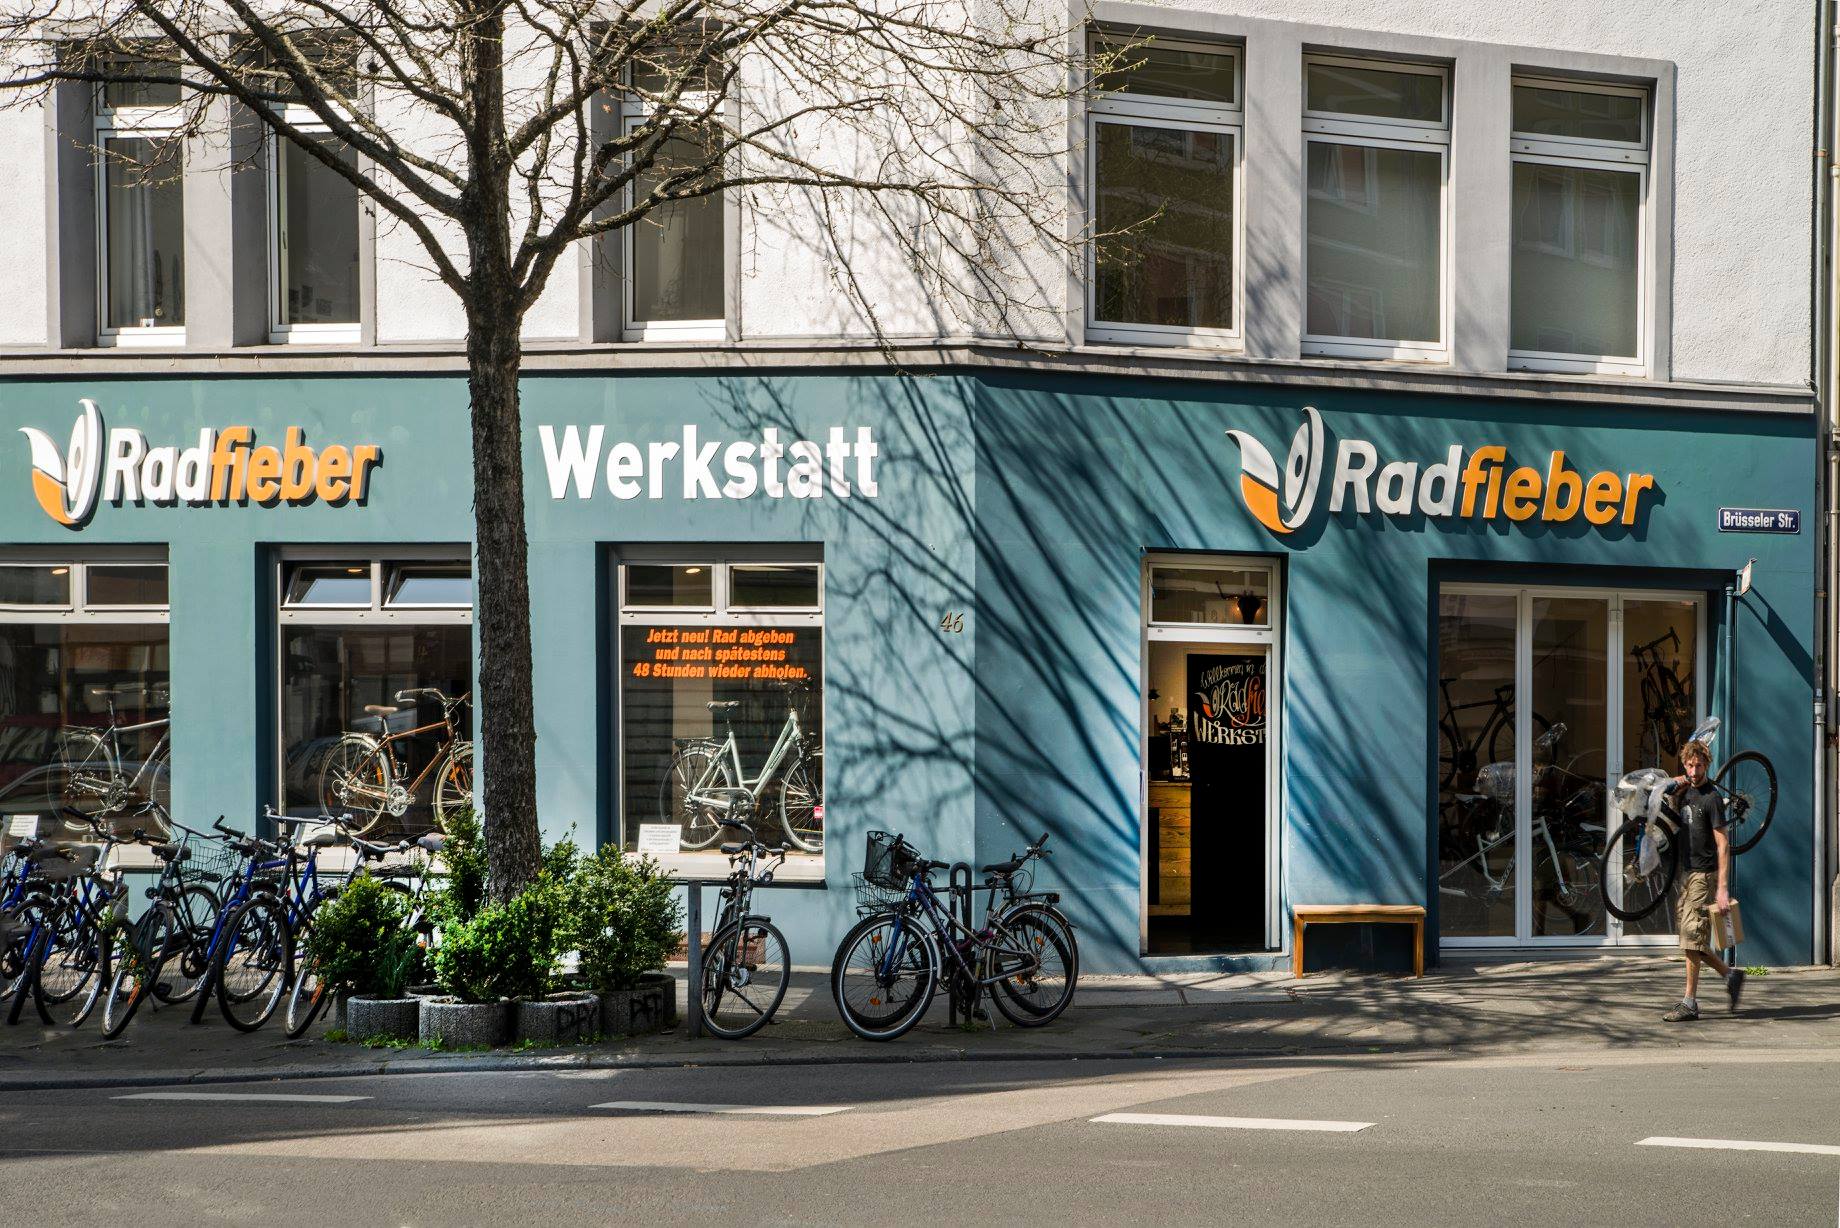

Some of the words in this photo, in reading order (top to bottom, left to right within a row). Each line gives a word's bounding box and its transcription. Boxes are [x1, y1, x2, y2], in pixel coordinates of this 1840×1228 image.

[104, 426, 381, 502] Radfieber
[538, 424, 879, 500] Werkstatt
[1329, 438, 1653, 526] Radfieber
[1723, 511, 1775, 528] Brüsseler
[1778, 512, 1796, 529] Str.
[940, 611, 964, 633] 46
[647, 628, 678, 644] Jetzt
[681, 629, 709, 644] neu!
[712, 629, 738, 644] Rad
[739, 629, 794, 646] abgeben
[655, 646, 680, 660] und
[682, 646, 712, 661] nach
[714, 646, 786, 662] spätestens
[633, 662, 650, 677] 48
[652, 662, 706, 678] Stunden
[708, 663, 751, 678] wieder
[753, 663, 808, 679] abholen.
[1219, 676, 1266, 727] Radfie
[1194, 711, 1266, 745] WERKST
